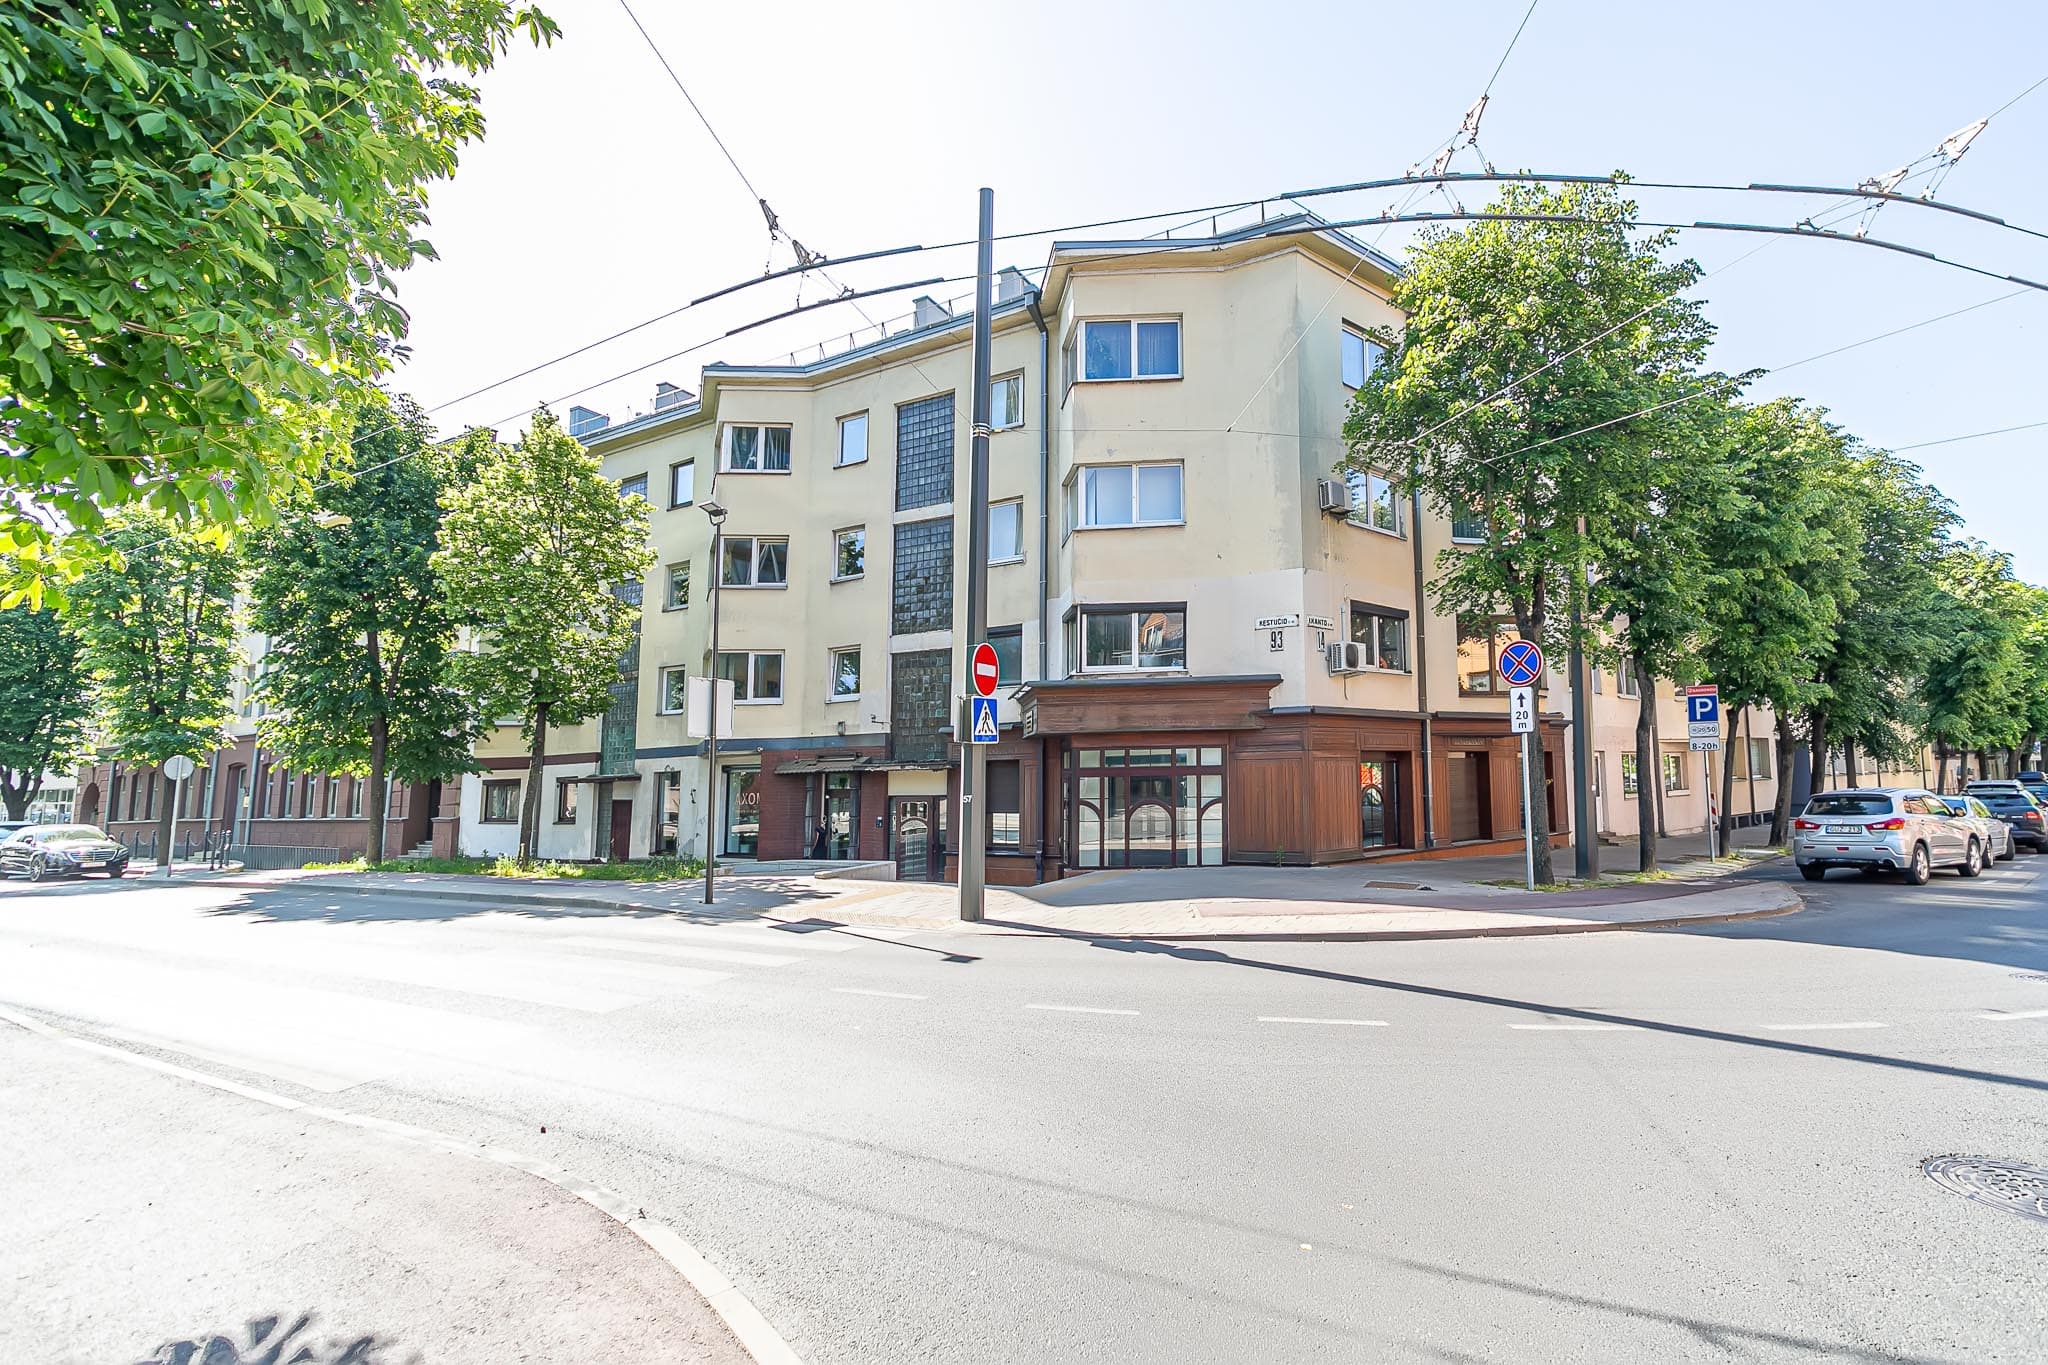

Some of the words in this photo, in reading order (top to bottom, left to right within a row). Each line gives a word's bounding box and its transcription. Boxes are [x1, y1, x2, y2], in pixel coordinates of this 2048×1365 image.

[1270, 630, 1283, 648] 93
[1515, 711, 1529, 720] 20
[1695, 698, 1713, 720] P
